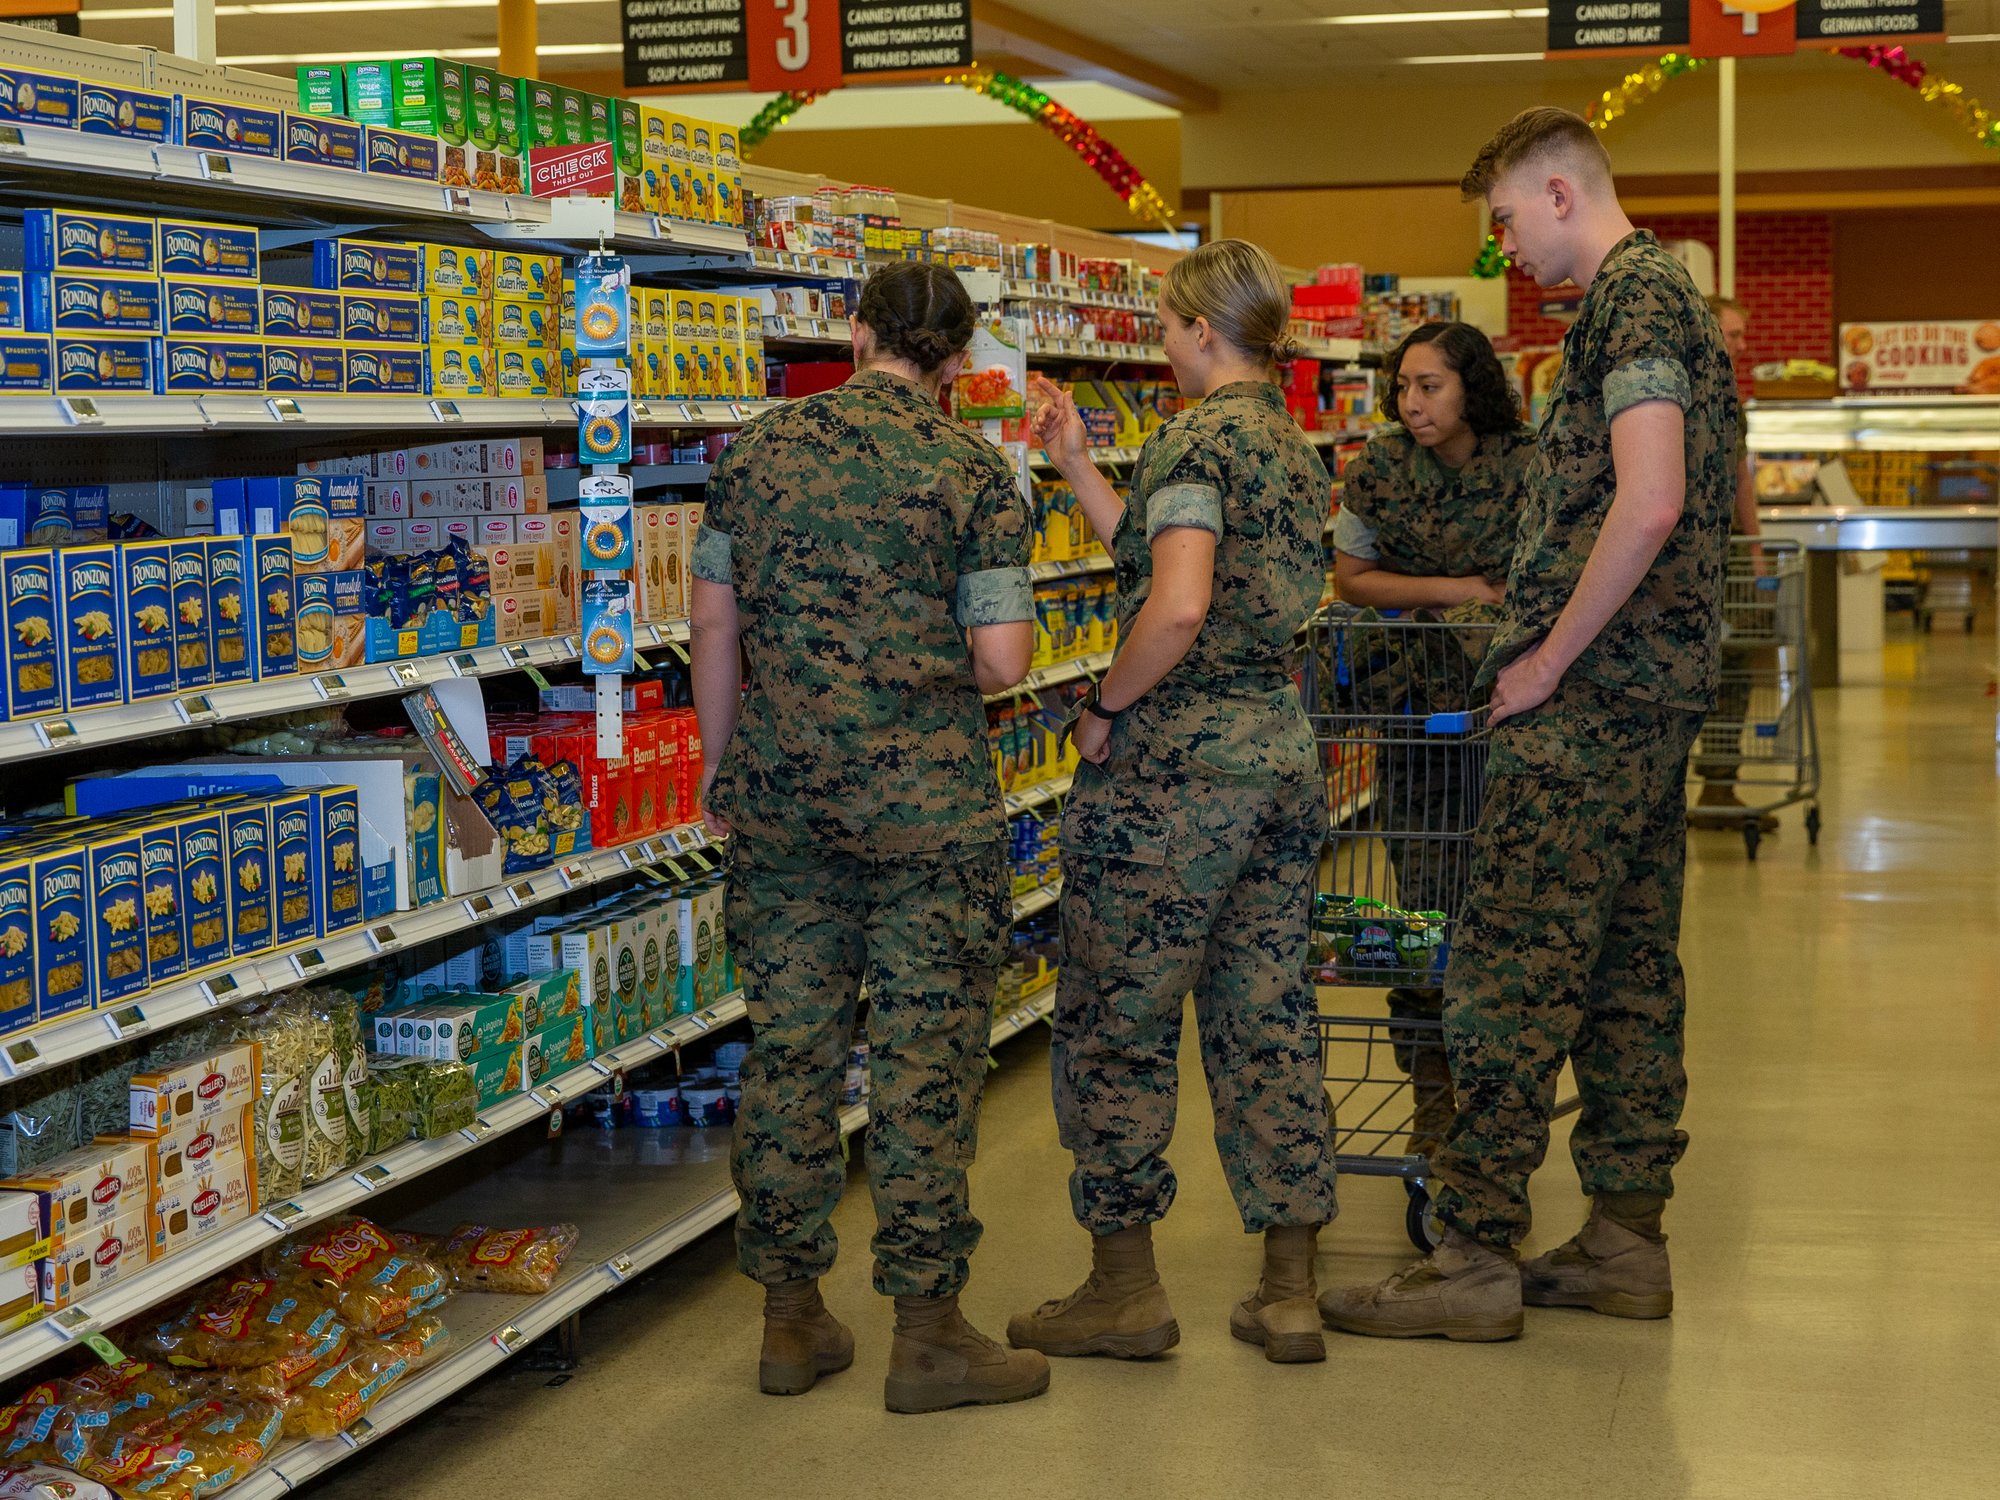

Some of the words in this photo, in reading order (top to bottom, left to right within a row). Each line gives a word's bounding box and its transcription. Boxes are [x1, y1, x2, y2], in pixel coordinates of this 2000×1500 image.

[847, 7, 894, 25] CANNED
[894, 2, 963, 22] VEGETABLES
[1575, 3, 1630, 21] CANNED
[1631, 2, 1661, 19] FISH
[629, 17, 740, 39] POTATOES/STUFFING
[1821, 16, 1873, 34] GERMAN
[1874, 14, 1919, 32] FOODS
[774, 0, 809, 71] 3
[845, 30, 889, 47] CANNED
[889, 27, 931, 44] TOMATO
[932, 24, 966, 42] SAUCE
[1575, 27, 1627, 45] CANNED
[1627, 25, 1663, 42] MEAT
[638, 44, 678, 60] RAMEN
[679, 40, 733, 58] NOODLES
[853, 51, 910, 69] PREPARED
[910, 47, 960, 65] DINNERS
[403, 79, 424, 87] Veggie
[648, 66, 677, 82] SOUP
[309, 87, 331, 95] Veggie
[358, 83, 380, 91] Veggie
[82, 95, 115, 119] RONZONI
[191, 112, 223, 133] RONZONI
[291, 126, 317, 146] RONZONI
[372, 139, 397, 159] RONZONI
[536, 150, 607, 183] CHECK
[552, 175, 577, 187] THESE
[578, 169, 594, 180] OUT
[62, 226, 97, 249] RONZONI
[167, 235, 199, 256] RONZONI
[345, 254, 372, 272] RONZONI
[434, 270, 451, 284] Gluten
[452, 273, 463, 285] Free
[497, 276, 516, 289] Gluten
[516, 279, 528, 290] Free
[61, 289, 98, 310] RONZONI
[174, 294, 205, 314] RONZONI
[268, 300, 294, 319] RONZONI
[348, 306, 374, 325] RONZONI
[438, 321, 454, 334] Gluten
[499, 324, 516, 337] Gluten
[517, 327, 528, 338] Free
[63, 351, 95, 372] RONZONI
[172, 352, 206, 373] RONZONI
[269, 355, 296, 375] RONZONI
[1876, 346, 1969, 366] COOKING
[350, 359, 376, 377] RONZONI
[440, 371, 457, 385] Gluten
[500, 372, 518, 386] Gluten
[519, 374, 531, 386] Free
[296, 483, 320, 499] RONZONI
[328, 478, 360, 501] homestyle
[41, 496, 66, 510] RONZONI
[376, 527, 395, 535] Barilla
[412, 525, 432, 533] Barilla
[173, 560, 202, 581] RONZONI
[212, 557, 240, 578] RONZONI
[262, 555, 289, 574] RONZONI
[12, 574, 48, 597] RONZONI
[72, 570, 110, 592] RONZONI
[133, 565, 166, 586] RONZONI
[334, 573, 362, 595] homestyle
[303, 583, 327, 598] RONZONI
[659, 740, 678, 757] Banza
[688, 735, 702, 752] Ban
[607, 754, 630, 771] Banza
[634, 748, 656, 764] Banza
[590, 774, 598, 808] Banza
[279, 818, 306, 841] RONZONI
[328, 809, 355, 831] RONZONI
[233, 827, 263, 850] RONZONI
[143, 848, 173, 870] RONZONI
[185, 837, 217, 861] RONZONI
[101, 861, 137, 887] RONZONI
[44, 875, 80, 900] RONZONI
[546, 991, 563, 1006] Linguine
[483, 1018, 503, 1033] Linguine
[549, 1037, 569, 1053] Spaghetti
[231, 1064, 246, 1077] 100%
[318, 1069, 331, 1086] al
[483, 1068, 504, 1082] Linguine
[199, 1077, 224, 1096] MUELLER'S
[221, 1123, 235, 1136] 100%
[187, 1136, 212, 1157] MUELLER'S
[127, 1166, 142, 1179] 100%
[93, 1180, 120, 1200] MUELLER'S
[226, 1179, 241, 1192] 100%
[193, 1192, 219, 1212] MUELLER'S
[127, 1227, 142, 1241] 100%
[28, 1249, 33, 1259] 2
[95, 1242, 121, 1262] MUELLER'S
